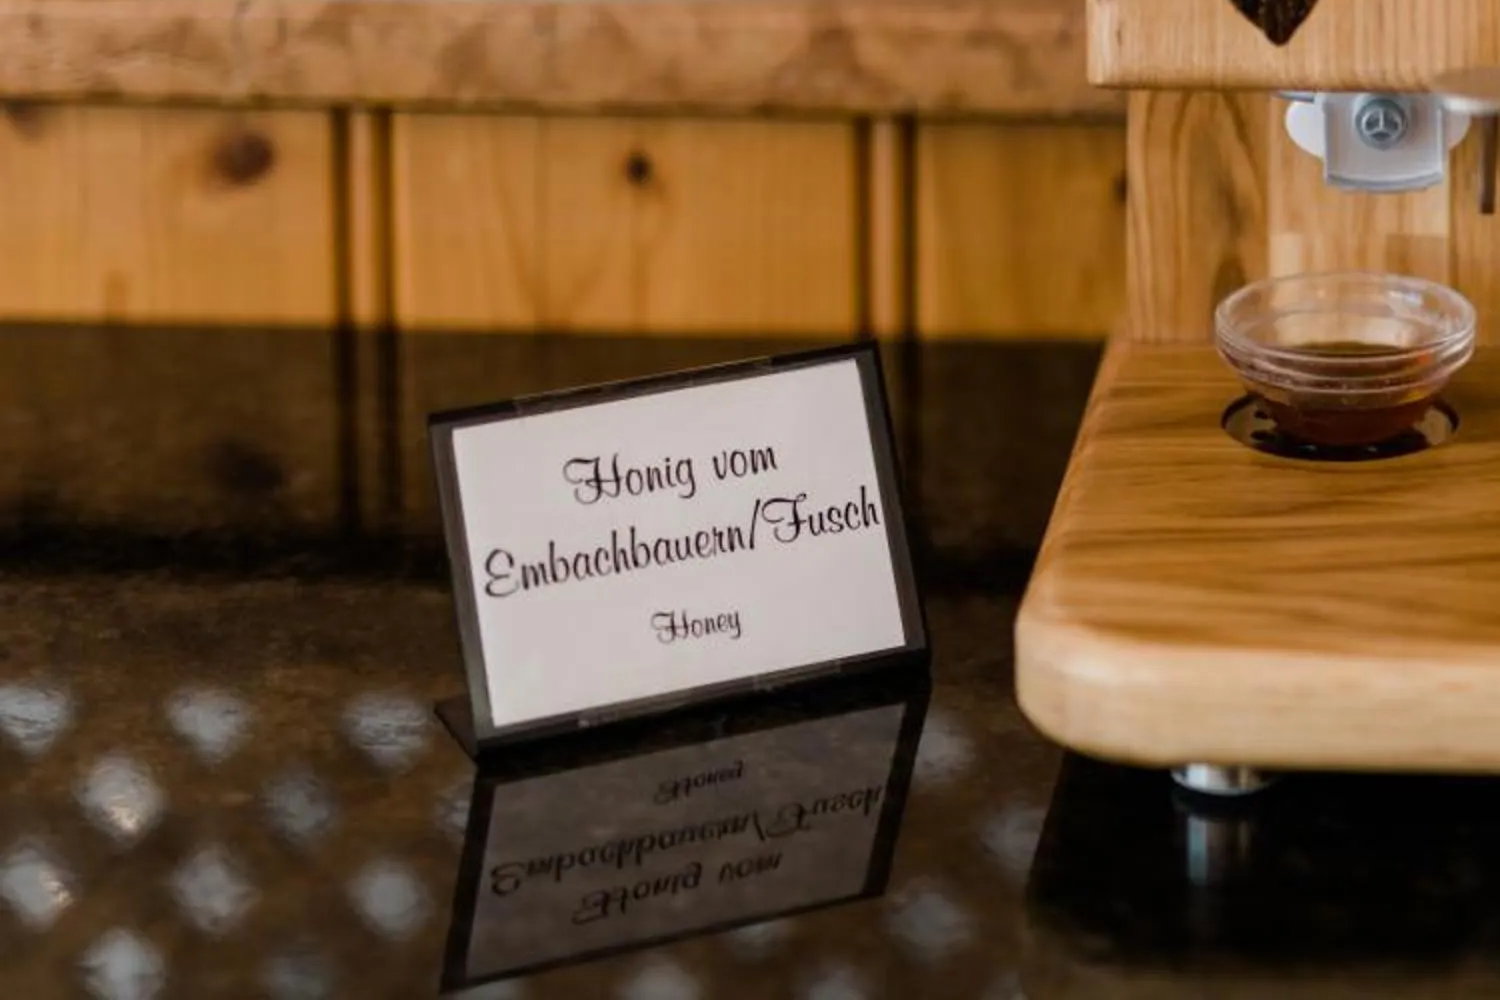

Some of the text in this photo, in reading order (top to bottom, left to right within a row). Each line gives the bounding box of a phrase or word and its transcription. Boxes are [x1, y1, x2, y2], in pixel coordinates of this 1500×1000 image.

[562, 445, 778, 505] Honig vom
[484, 485, 882, 598] Embachbauern/Fusch
[650, 609, 742, 644] Honey
